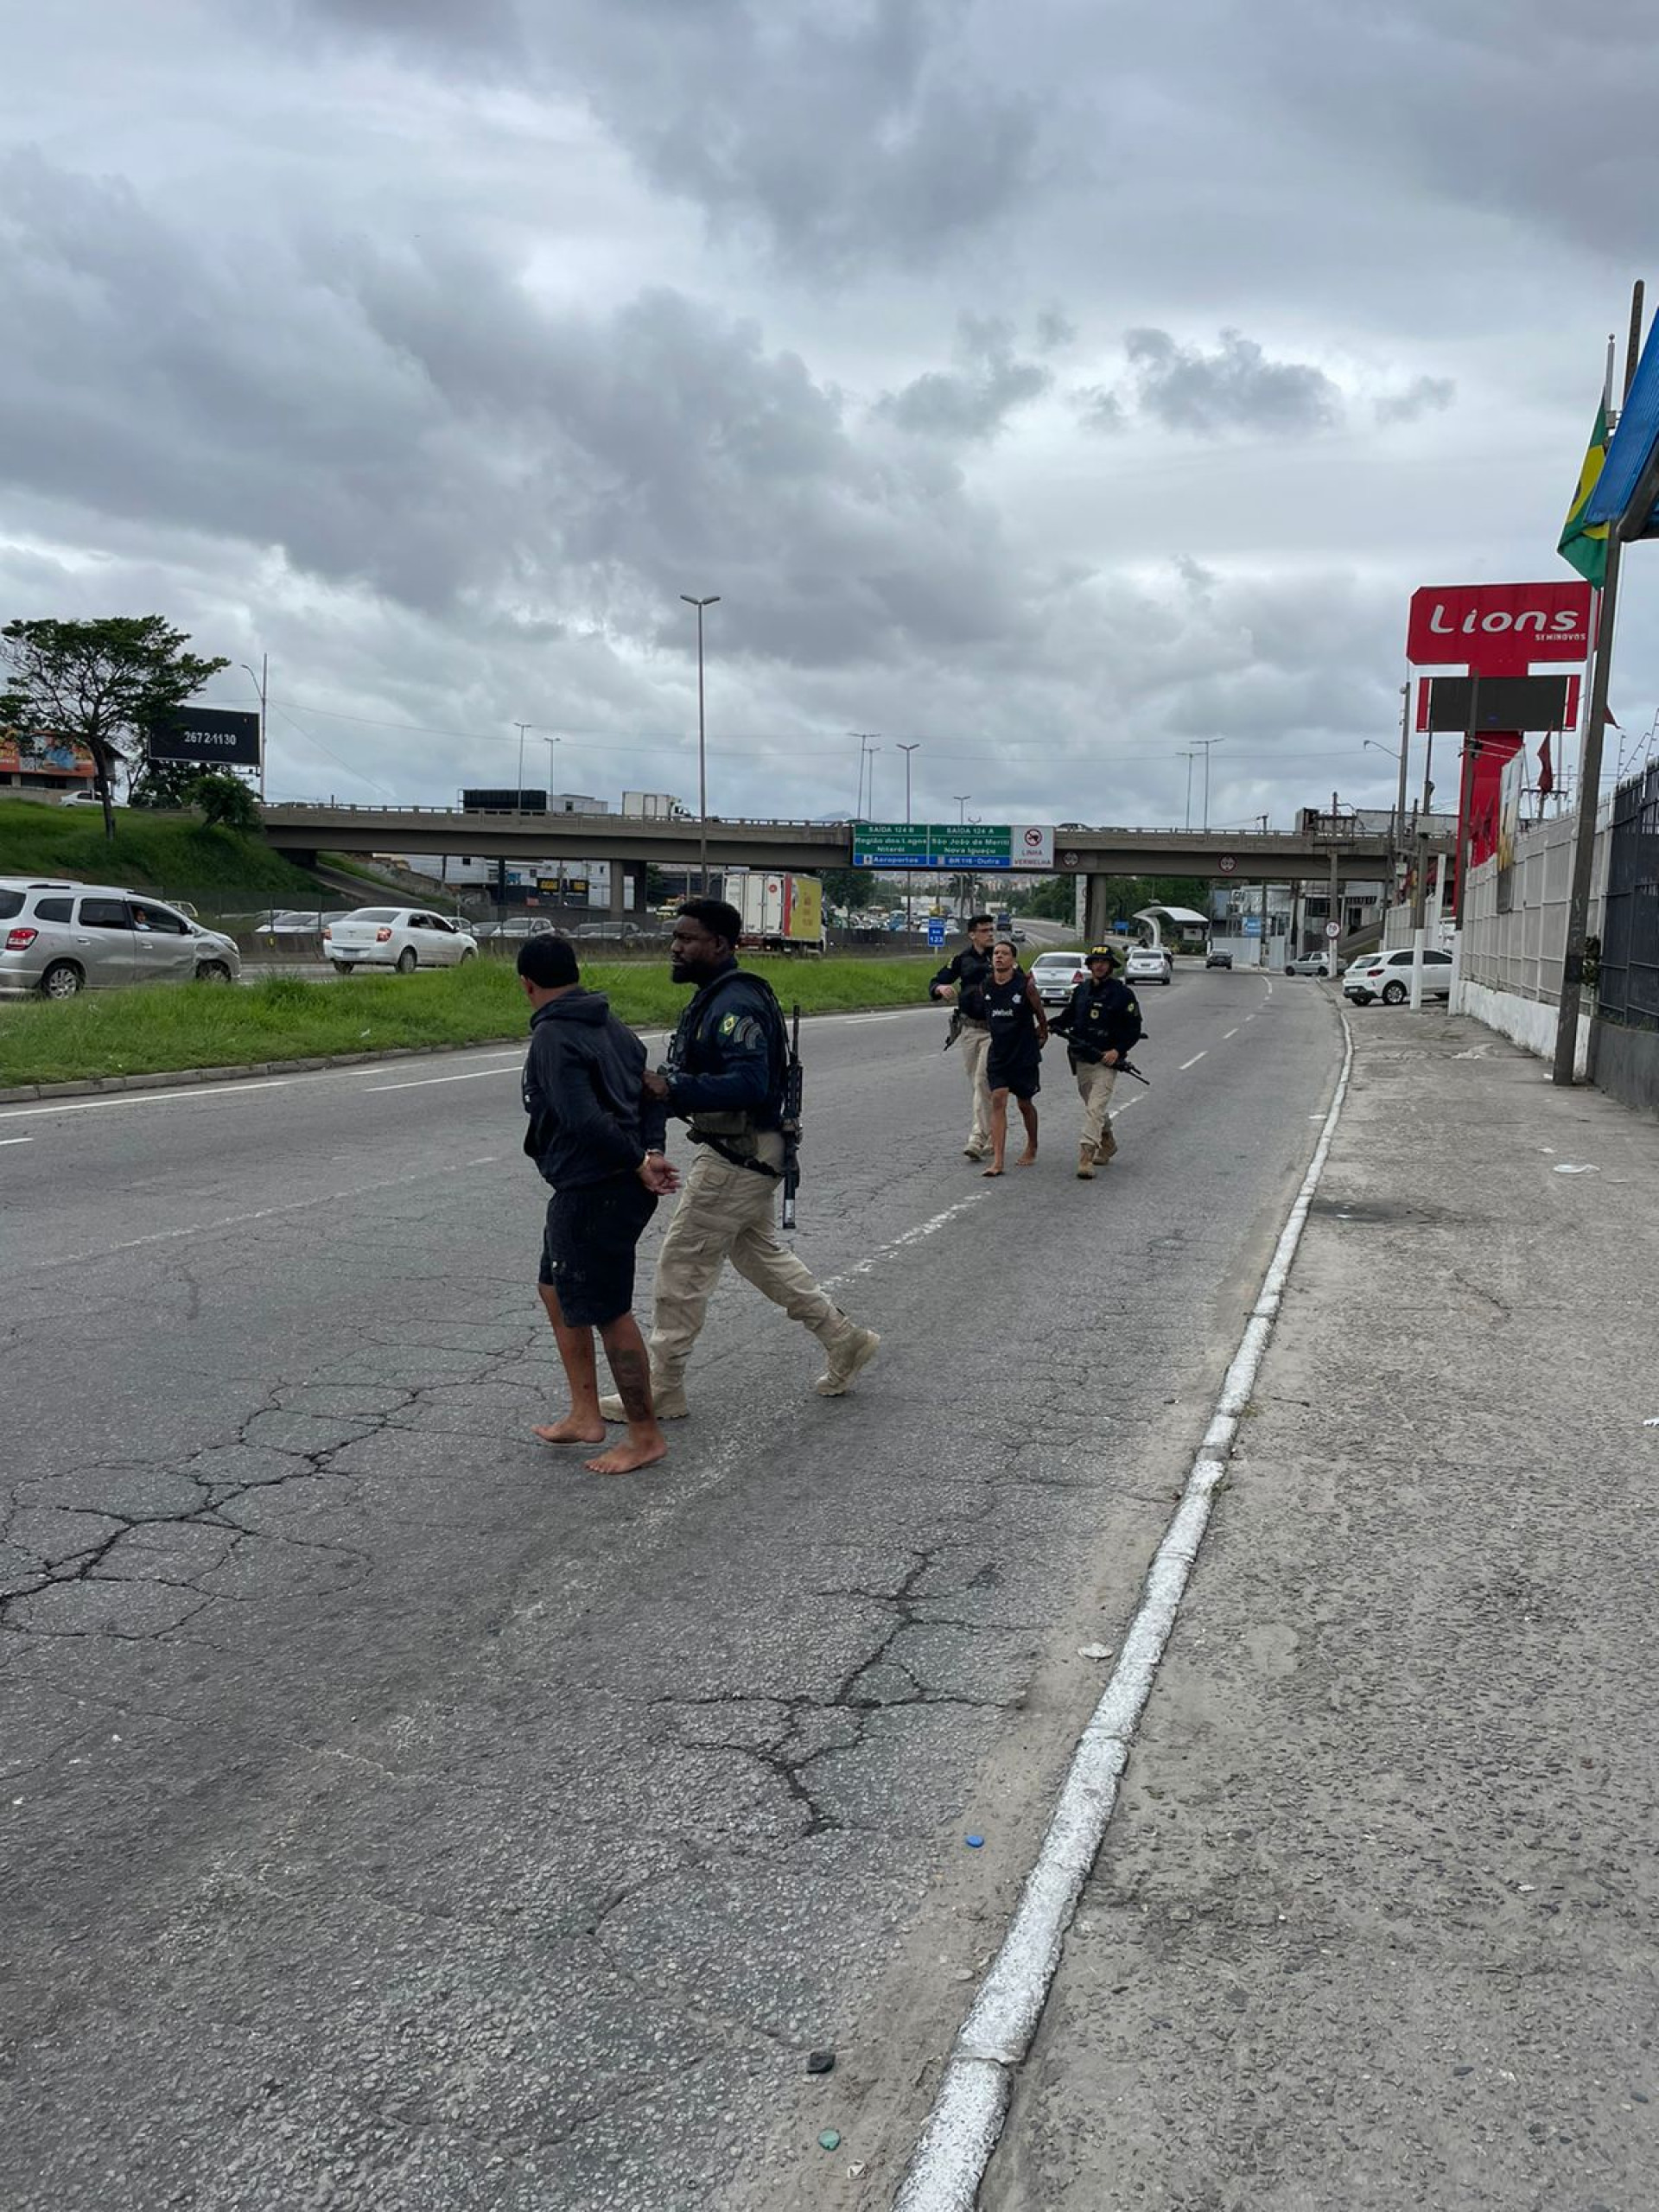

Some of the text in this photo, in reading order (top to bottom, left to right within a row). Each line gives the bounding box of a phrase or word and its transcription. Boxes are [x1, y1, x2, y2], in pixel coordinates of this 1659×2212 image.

[1429, 604, 1580, 634] Lions
[1535, 632, 1586, 641] SEMINOVOS
[184, 731, 238, 746] 2672-1130
